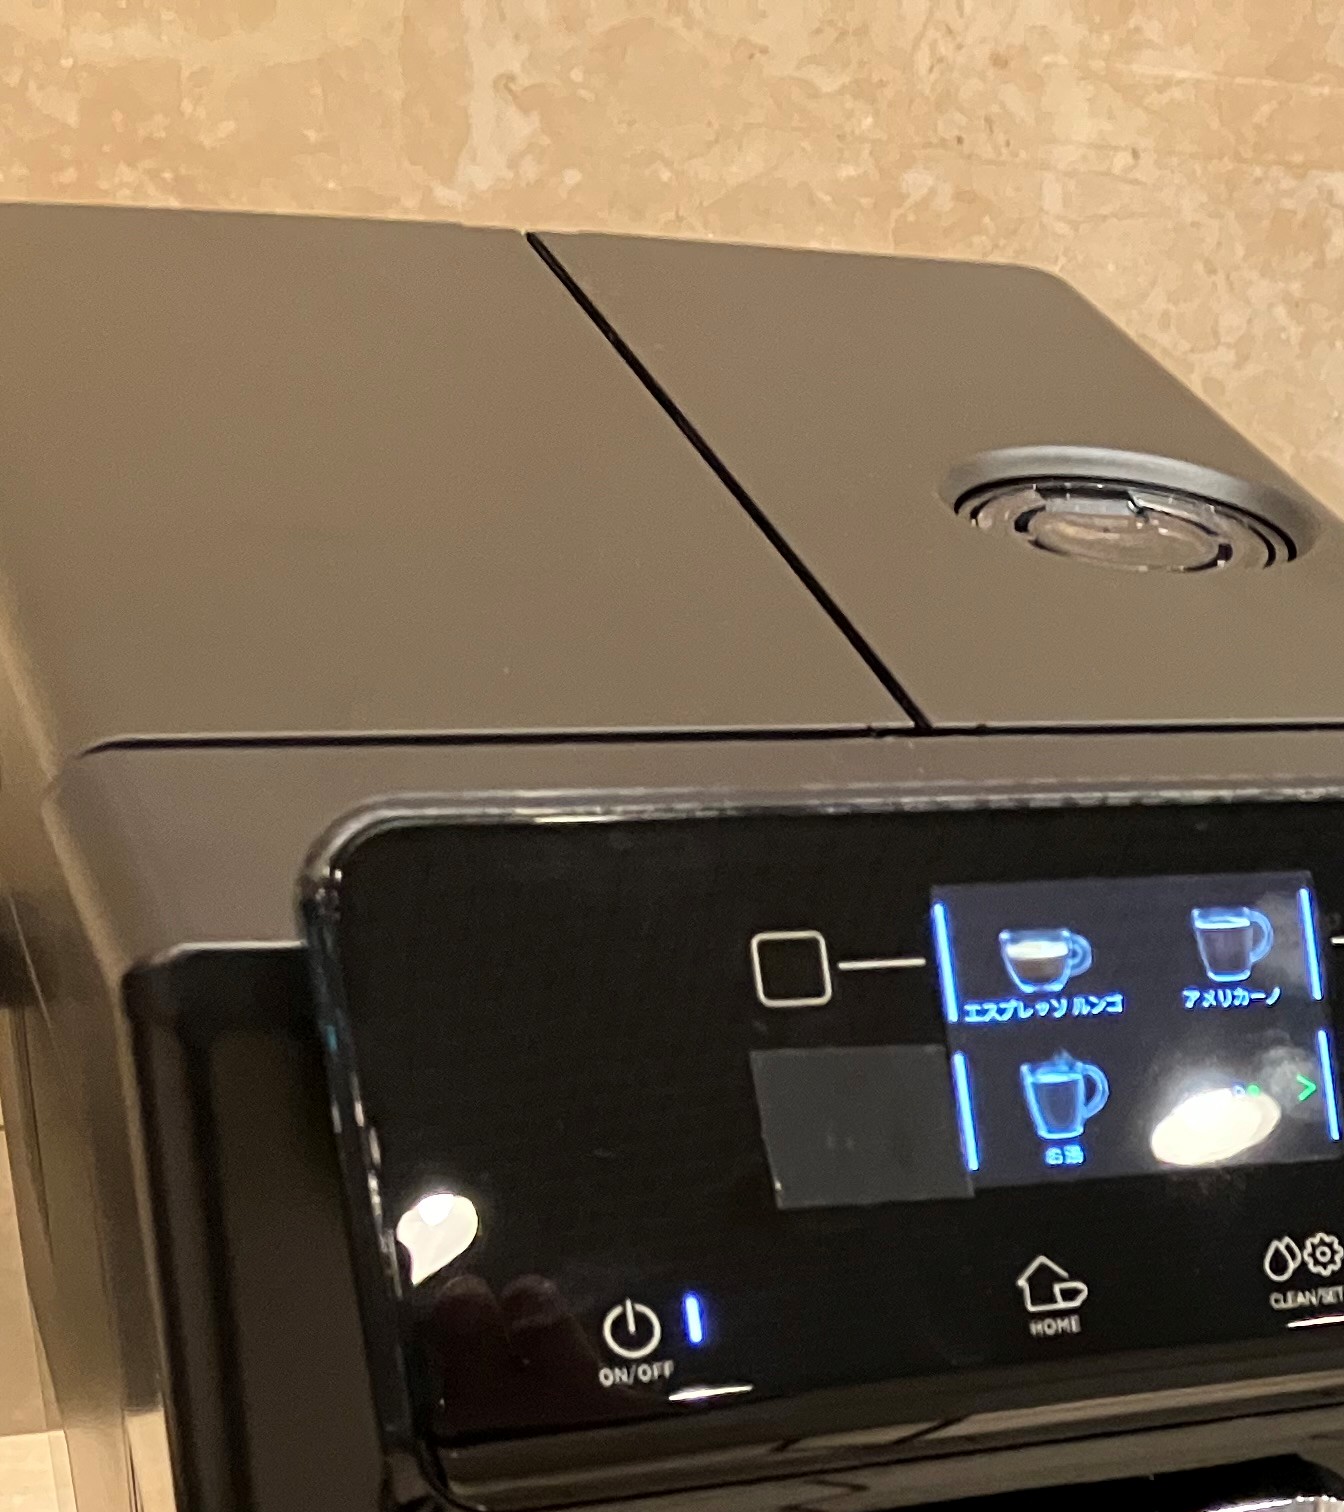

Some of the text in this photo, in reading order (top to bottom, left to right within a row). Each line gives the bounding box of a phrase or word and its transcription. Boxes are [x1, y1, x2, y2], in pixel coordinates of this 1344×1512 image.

[1182, 986, 1281, 1009] アメリカーノ
[1029, 1314, 1081, 1337] HOME
[598, 1360, 675, 1388] ON/OFF
